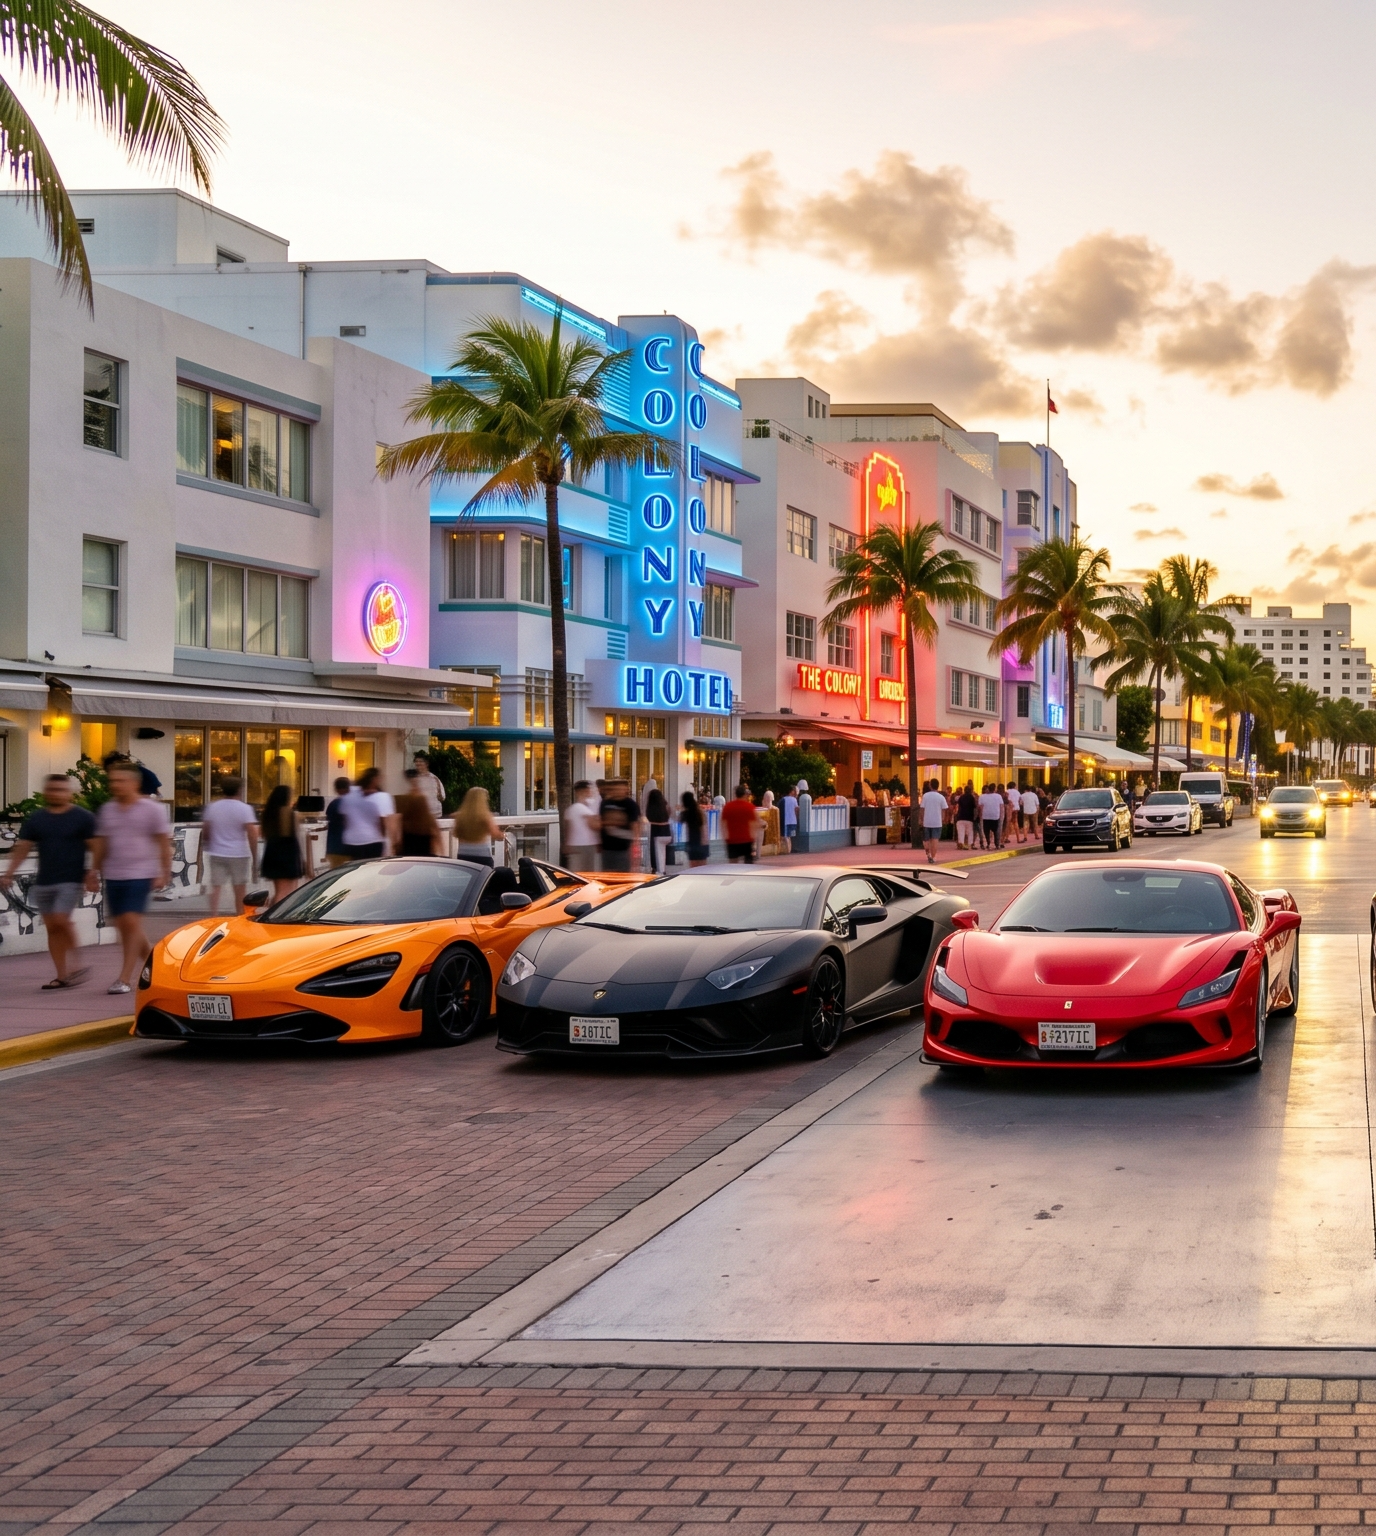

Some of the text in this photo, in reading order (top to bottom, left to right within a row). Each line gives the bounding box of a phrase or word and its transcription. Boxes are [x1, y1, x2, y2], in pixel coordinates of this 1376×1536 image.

[643, 336, 675, 635] COLONY
[688, 342, 707, 638] COLONY
[624, 665, 733, 710] HOTEL
[801, 665, 821, 690] THE
